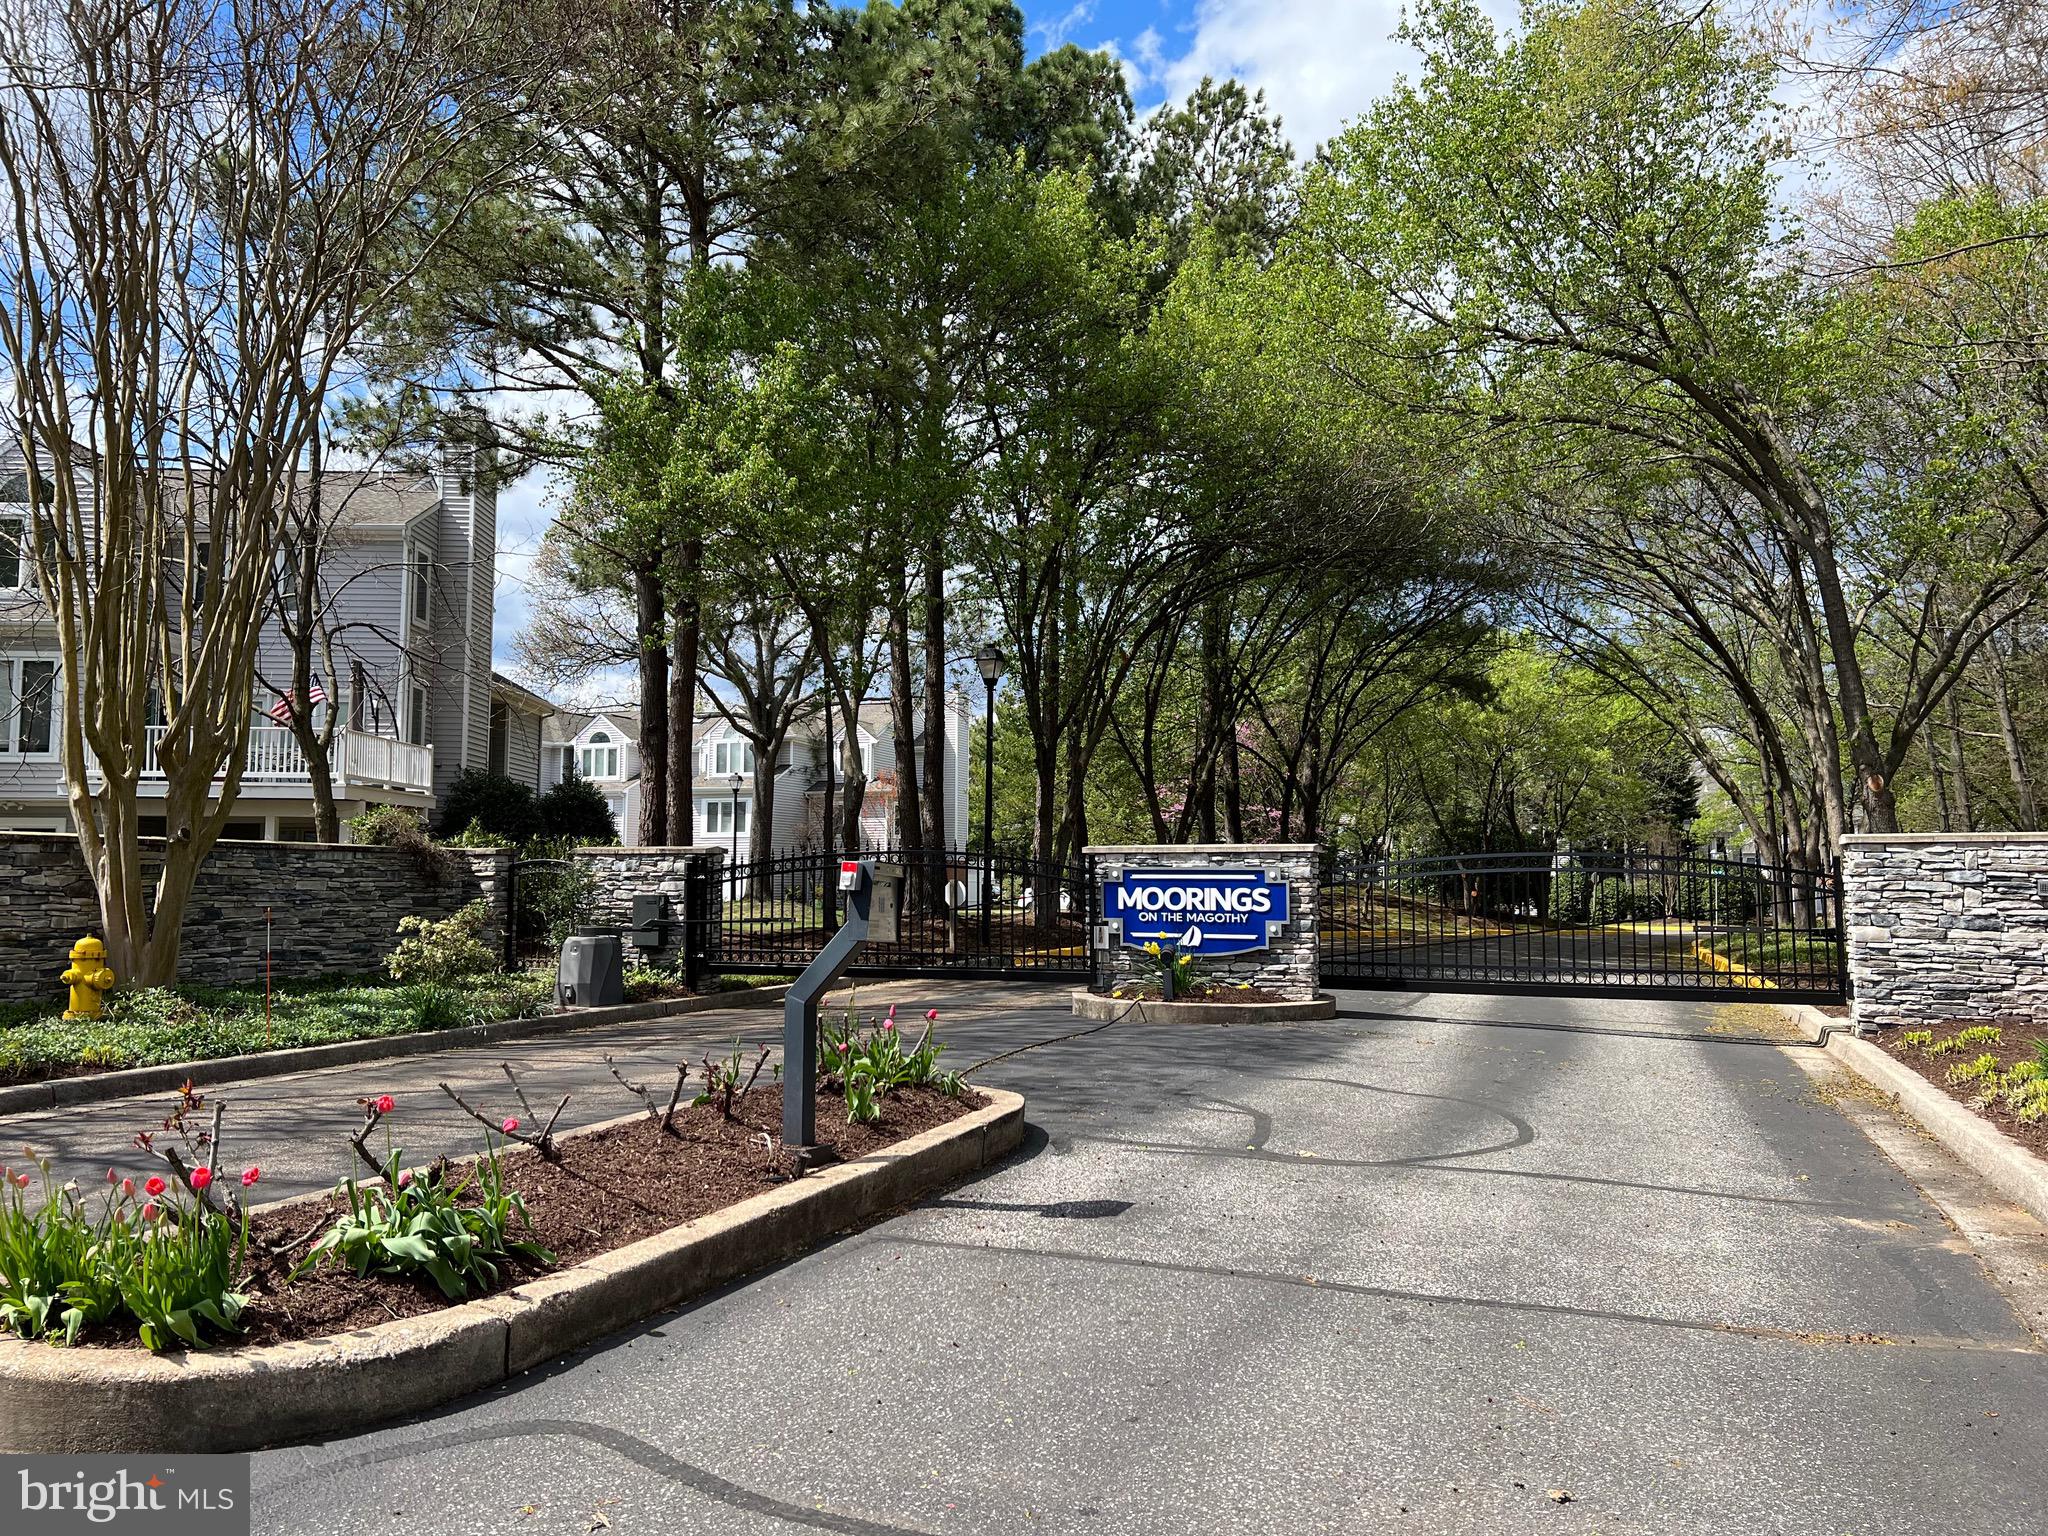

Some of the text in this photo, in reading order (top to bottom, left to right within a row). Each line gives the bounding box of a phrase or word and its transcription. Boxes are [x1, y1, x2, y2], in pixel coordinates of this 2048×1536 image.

[1117, 886, 1271, 913] MOORINGS
[1138, 912, 1249, 924] ON THE MAGOTHY
